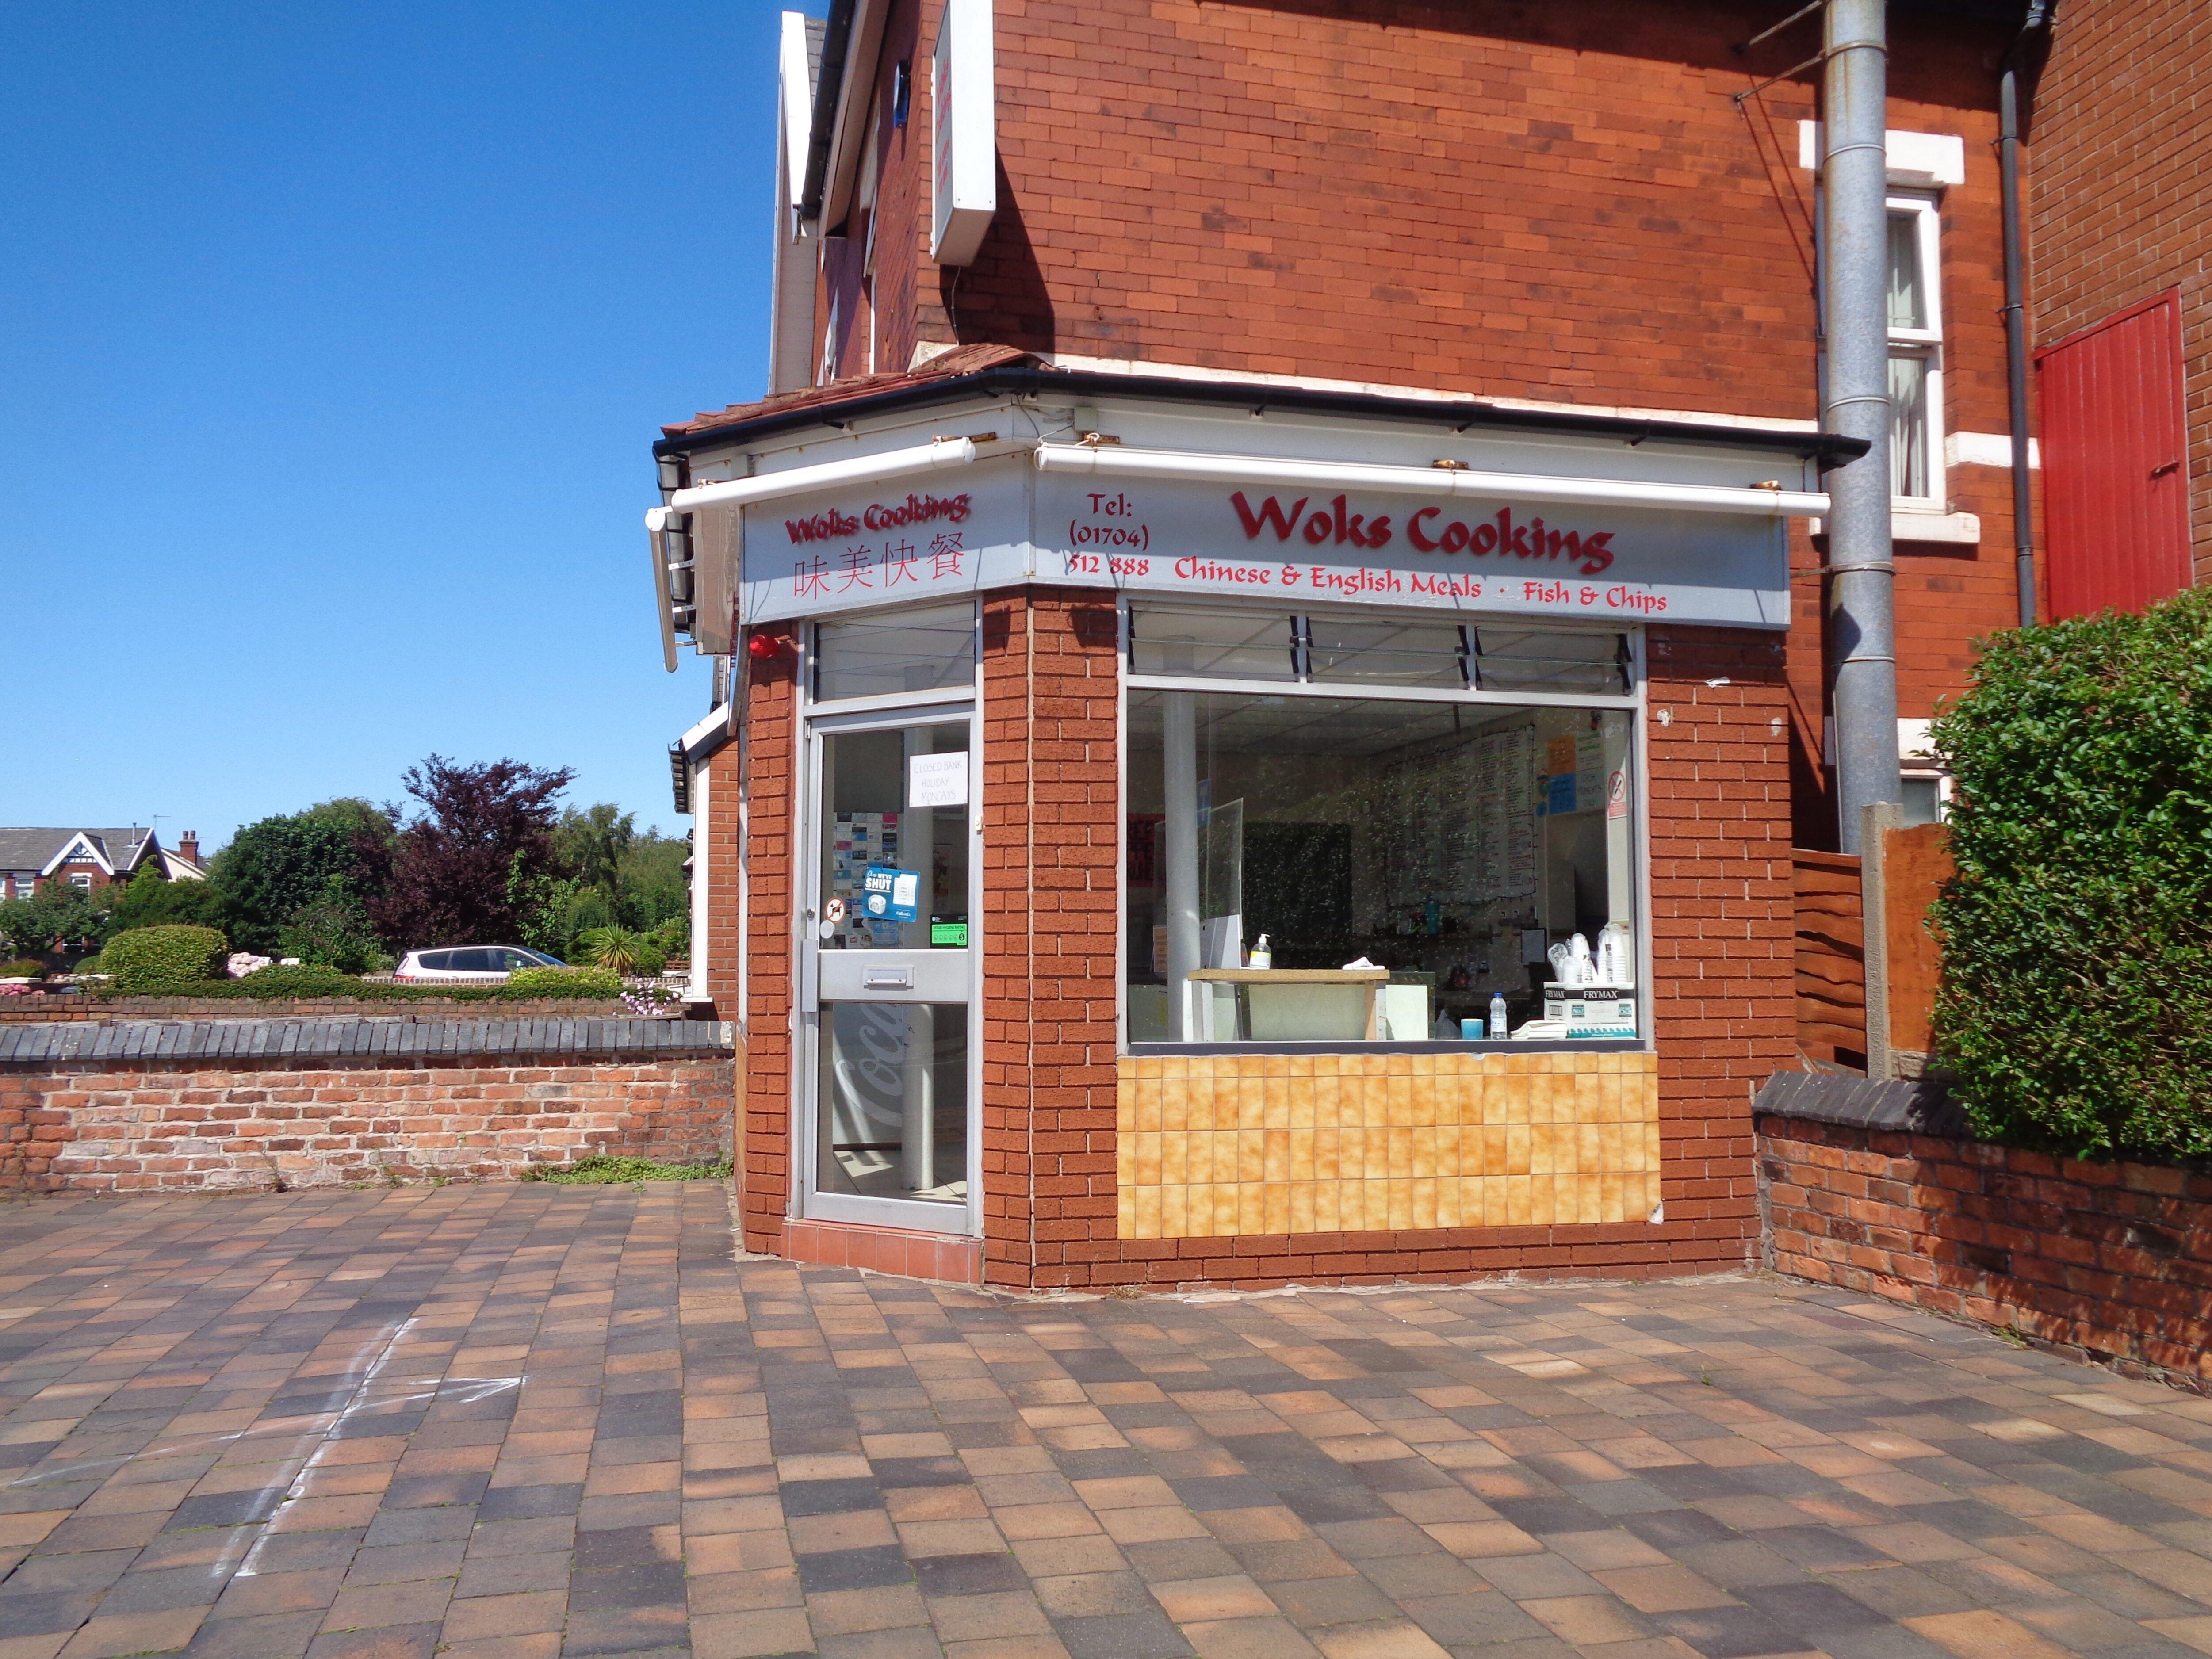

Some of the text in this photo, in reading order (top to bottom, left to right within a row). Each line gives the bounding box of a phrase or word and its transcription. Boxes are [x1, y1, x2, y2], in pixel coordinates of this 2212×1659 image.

[1086, 493, 1132, 516] Tel:
[785, 493, 970, 544] Woks Cooking
[1069, 519, 1149, 551] (01704)
[1231, 490, 1615, 574] Woks Cooking
[794, 531, 965, 600] 味美快餐
[1069, 554, 1150, 576] 512 888
[1174, 556, 1668, 615] Chinese & English Meals Fish & Chips
[914, 760, 962, 773] CLOSED BANK
[922, 777, 949, 787] HOLIDAY
[921, 789, 956, 802] MONDAYS
[865, 877, 892, 890] SHUT
